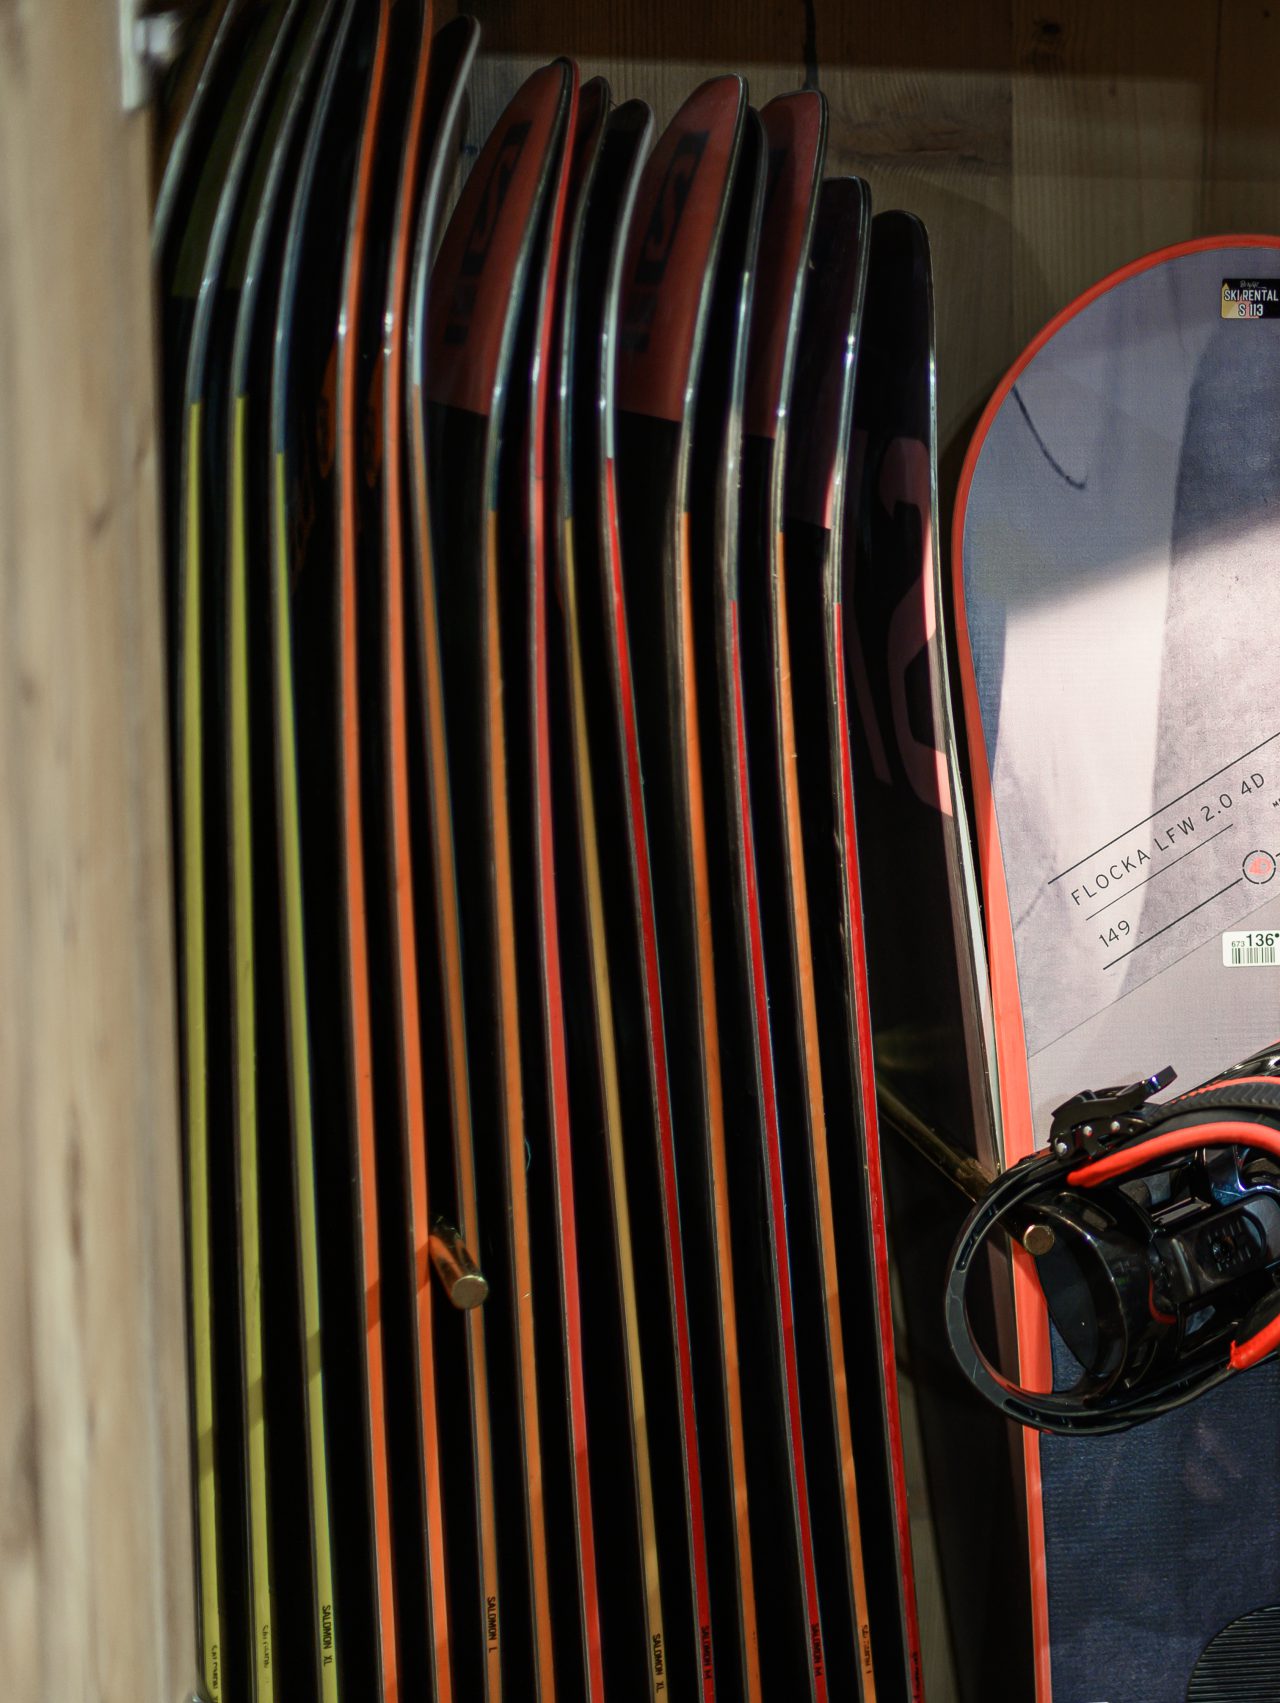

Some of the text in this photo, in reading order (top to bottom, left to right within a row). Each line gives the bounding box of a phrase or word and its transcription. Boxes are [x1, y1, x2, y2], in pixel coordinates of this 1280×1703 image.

[1224, 289, 1279, 301] SKI RENTAL
[1238, 303, 1264, 316] S 113
[1071, 773, 1265, 906] FLOCKA LFW 2.0 4D
[1099, 920, 1130, 947] 149
[1231, 940, 1245, 948] 673
[322, 1604, 332, 1667] SALOMON XL
[487, 1596, 497, 1641] SALOMON
[652, 1633, 664, 1693] SALOMON XL
[701, 1625, 711, 1666] SALOMON
[811, 1622, 822, 1664] SALOMON
